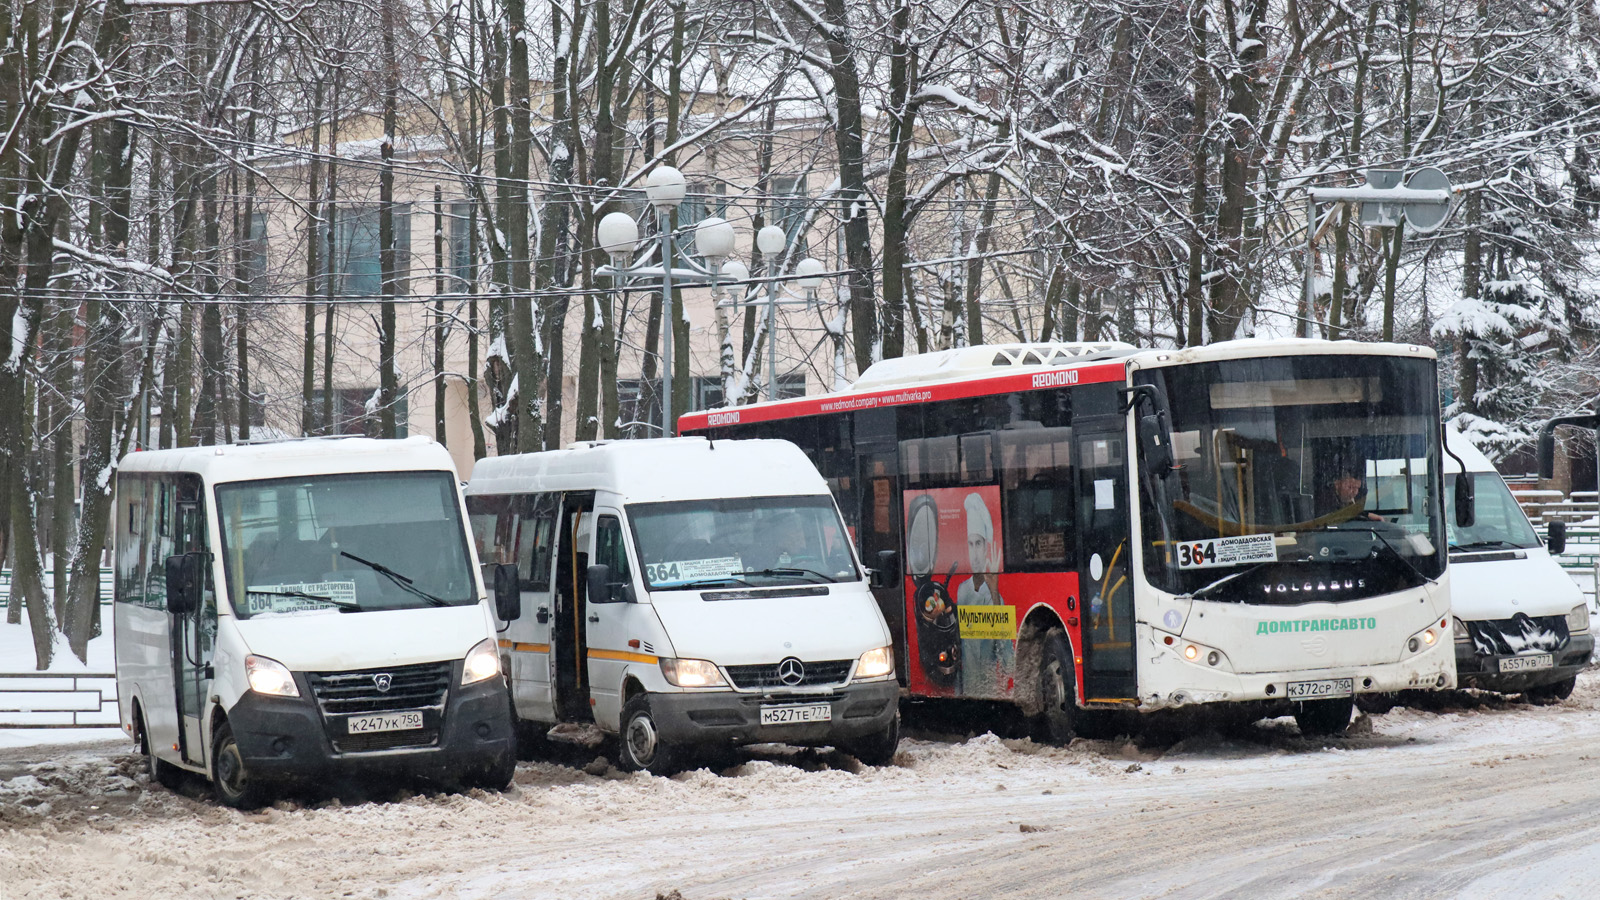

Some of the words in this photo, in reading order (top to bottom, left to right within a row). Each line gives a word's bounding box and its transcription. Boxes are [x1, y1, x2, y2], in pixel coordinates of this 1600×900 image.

[1032, 369, 1079, 388] REDMOND
[820, 397, 878, 411] www.redmond.company
[882, 390, 932, 404] www.multivarka.pro
[1220, 536, 1272, 547] ДОМОДЕДОВСКАЯ
[1180, 542, 1217, 567] 364
[646, 563, 681, 583] 364
[280, 584, 304, 594] ВИДНОЕ
[315, 582, 354, 592] РАСТОРГУЕВО
[1263, 579, 1366, 594] VOLGABUS
[250, 593, 273, 611] 364
[959, 608, 1009, 628] Мультикухня
[1256, 617, 1376, 635] ДОМТРАНСАВТО
[1291, 683, 1332, 696] К372СР
[1333, 680, 1350, 690] 750
[352, 717, 399, 732] К247УК
[401, 713, 419, 725] 750
[764, 709, 809, 722] М527ТЕ
[811, 706, 828, 717] 777
